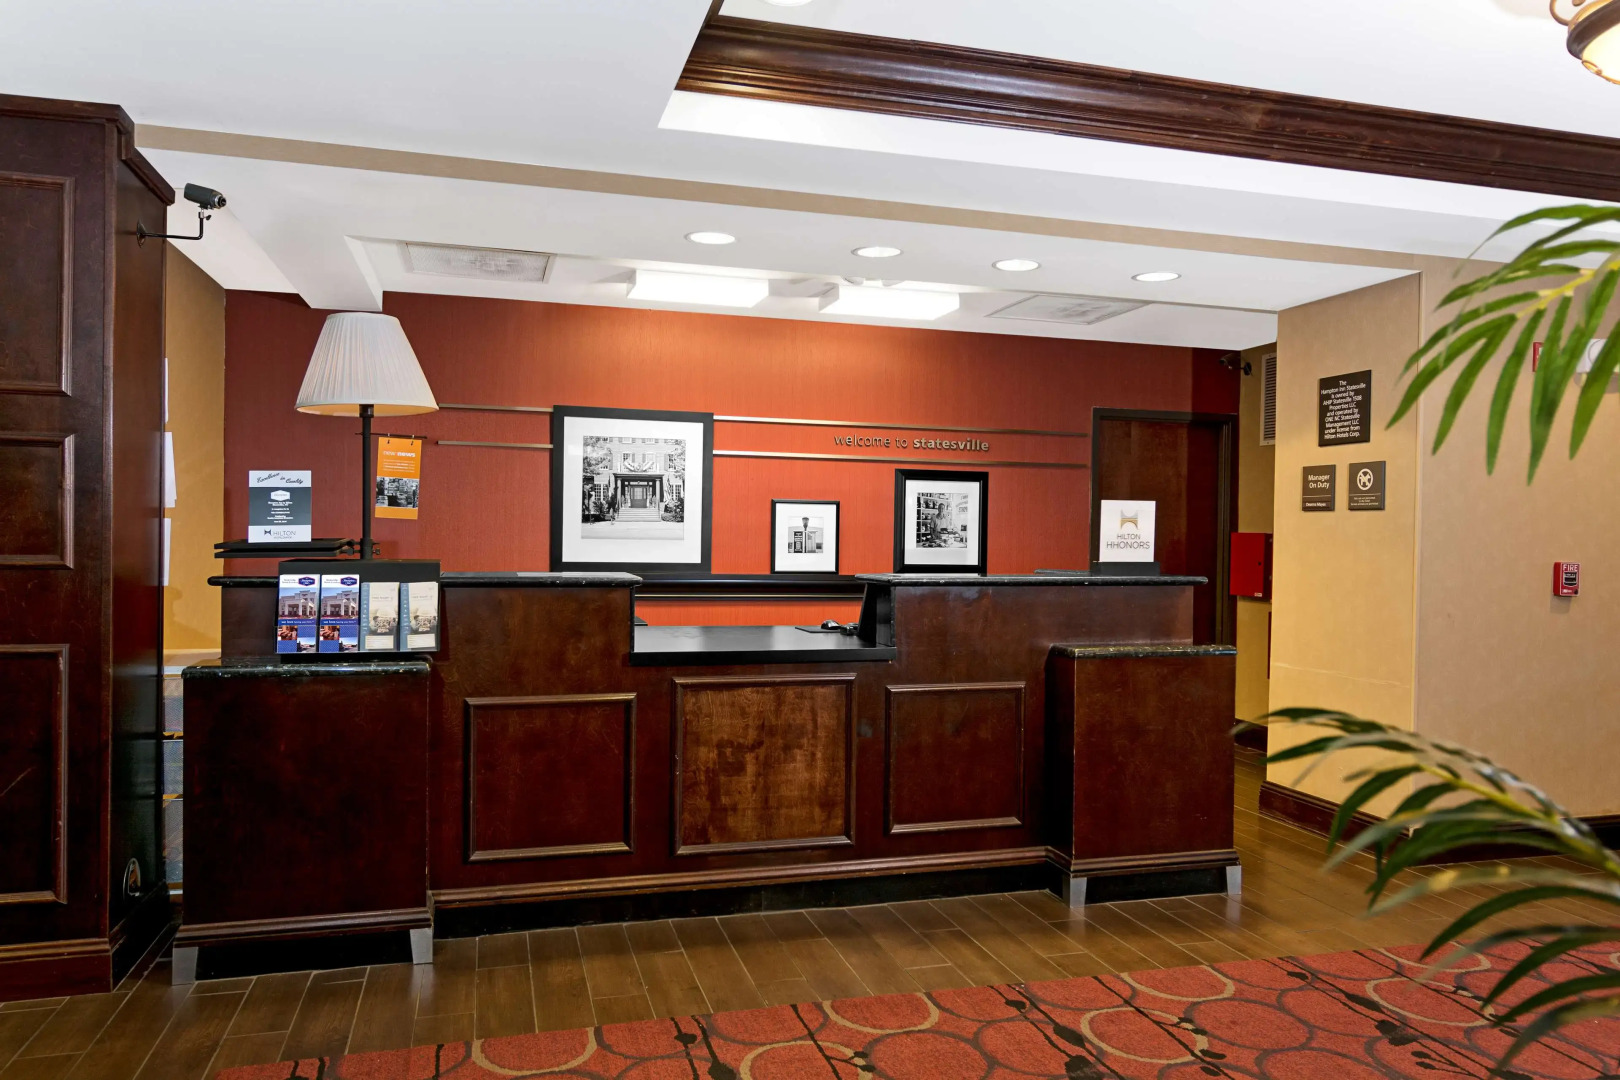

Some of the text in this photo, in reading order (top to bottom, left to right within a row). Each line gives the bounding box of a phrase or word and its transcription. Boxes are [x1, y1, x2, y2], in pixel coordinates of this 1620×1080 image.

[1346, 382, 1366, 391] Statesville
[1333, 396, 1352, 404] Statesville
[1335, 408, 1353, 416] operated
[1325, 420, 1352, 428] Management
[834, 434, 989, 451] welcome to statesville
[1308, 474, 1330, 482] Manager
[1106, 541, 1150, 550] HHONORS
